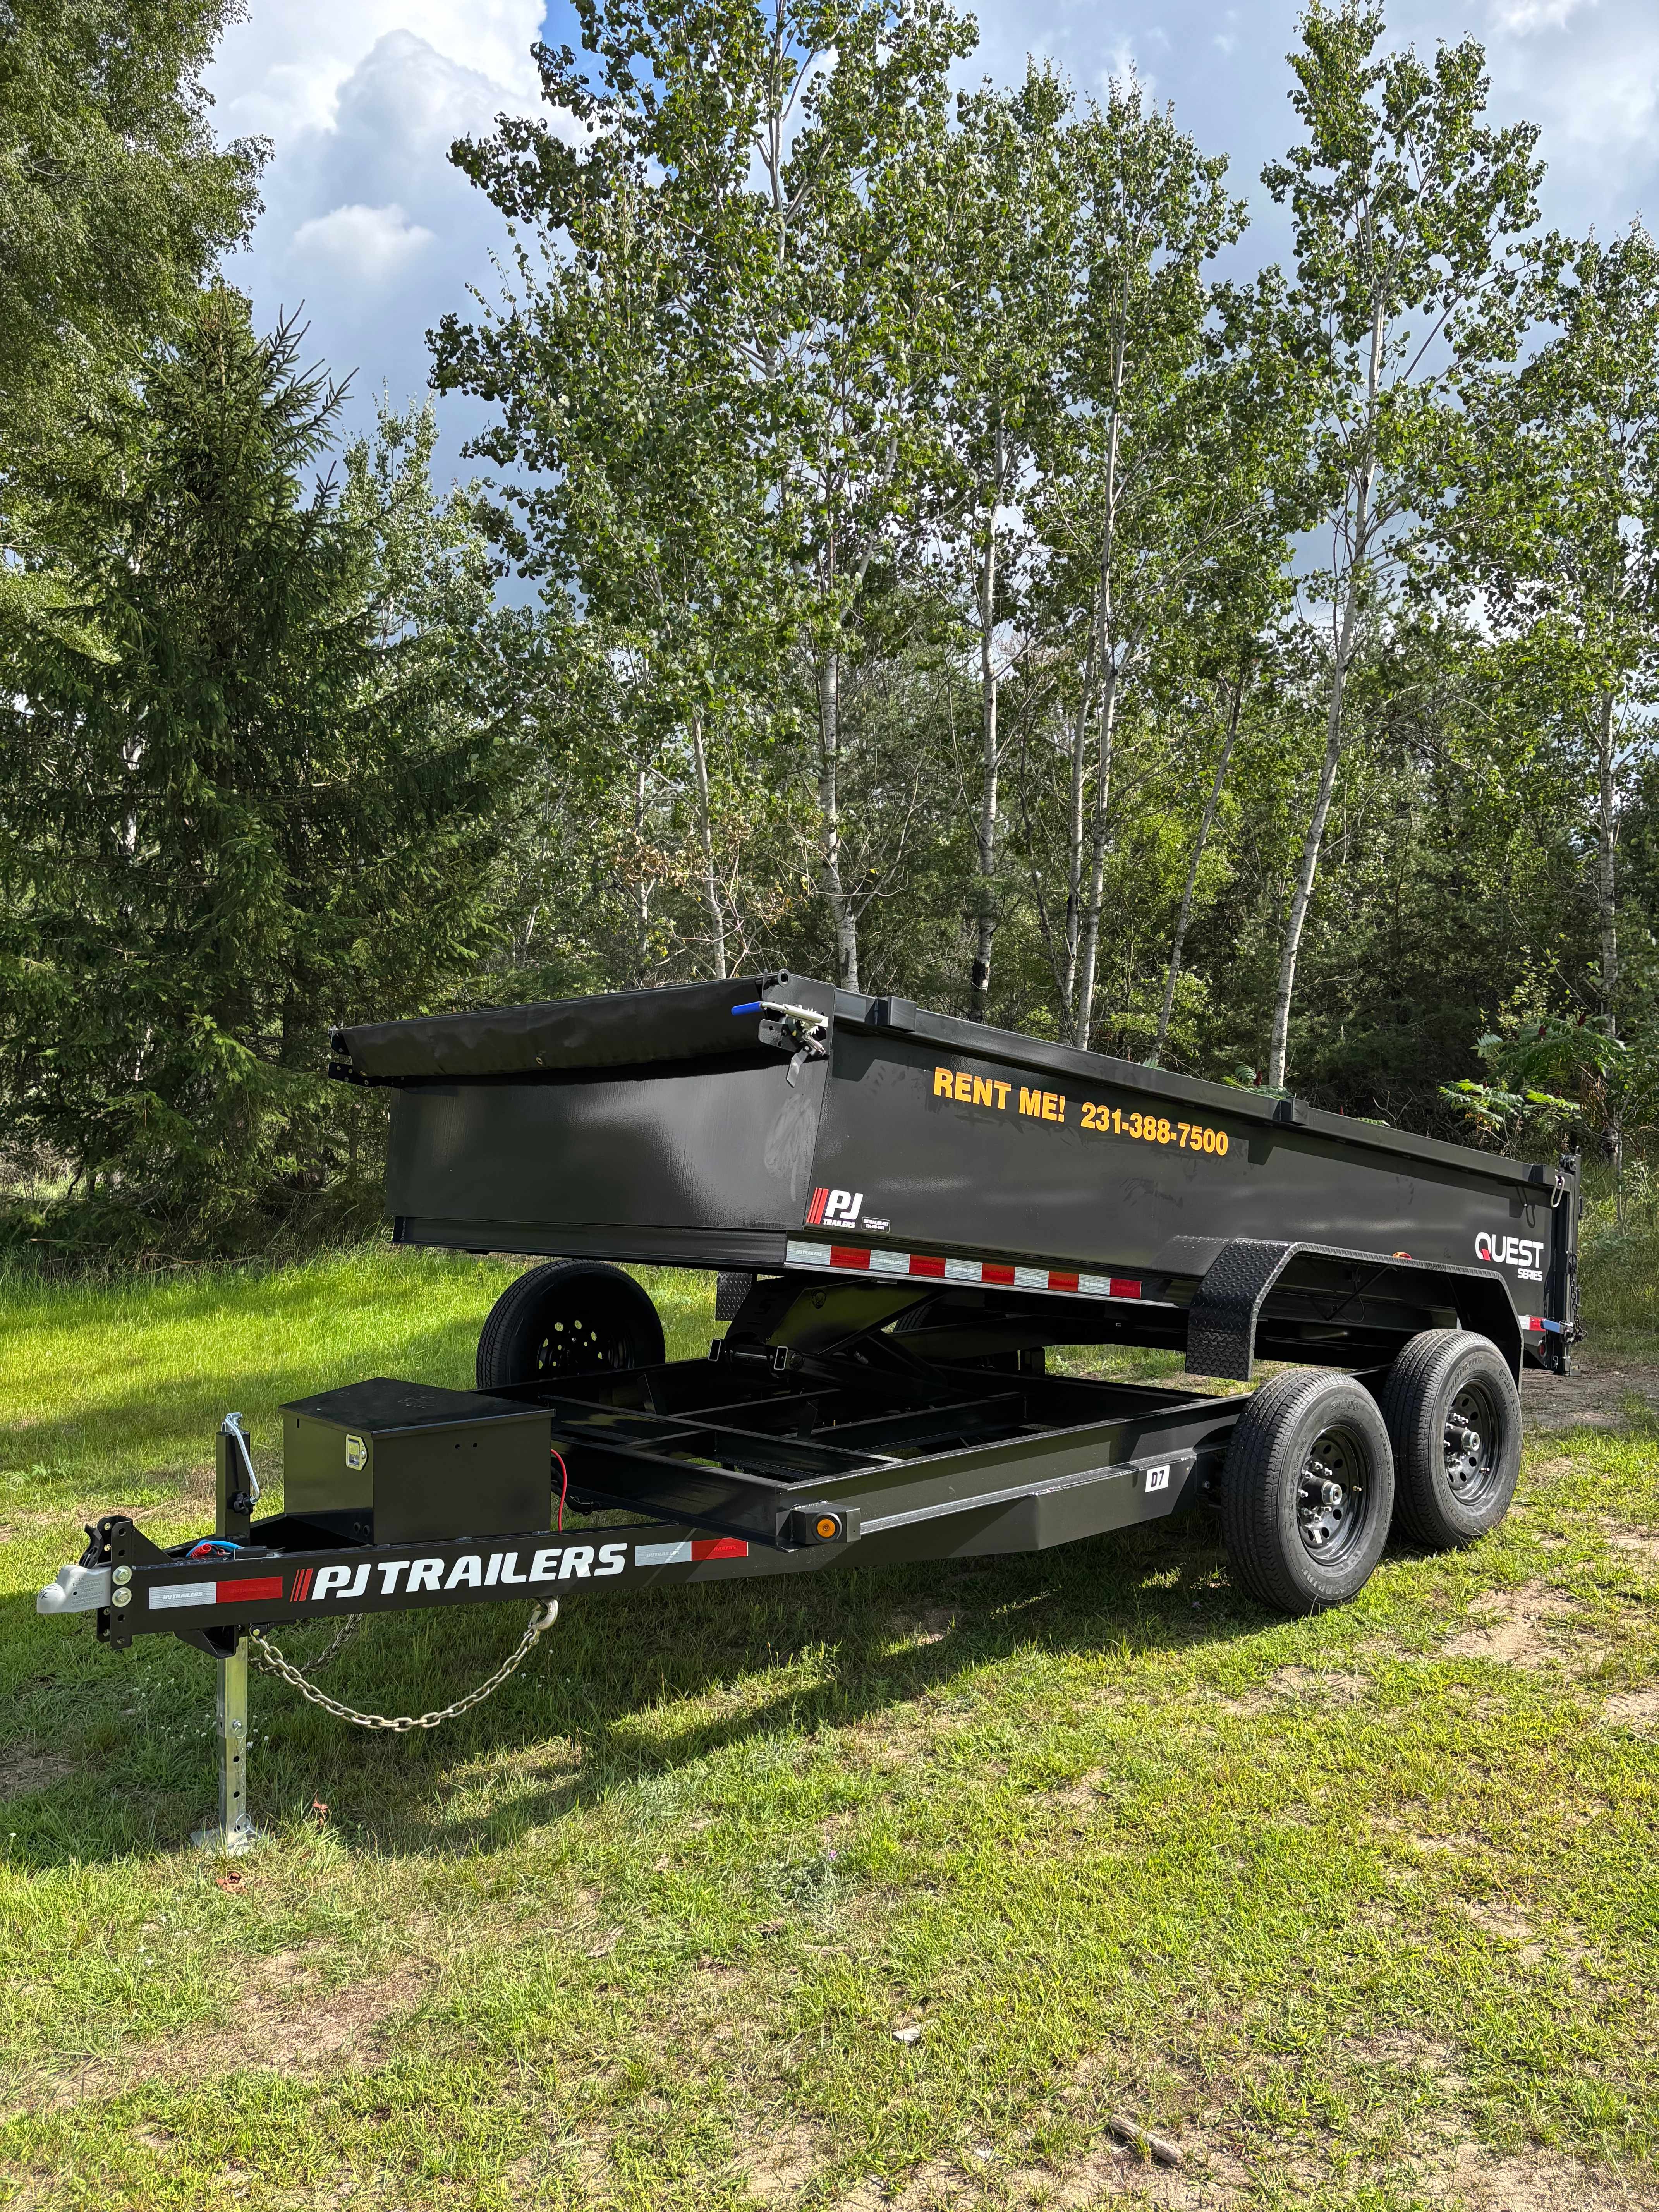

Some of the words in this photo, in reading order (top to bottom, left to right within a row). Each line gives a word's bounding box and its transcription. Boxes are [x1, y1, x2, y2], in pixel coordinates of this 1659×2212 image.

[934, 1067, 1011, 1110] RENT
[1019, 1087, 1065, 1122] ME!
[1081, 1103, 1228, 1156] 231-388-7500
[824, 1190, 864, 1220] PJ
[823, 1218, 856, 1229] TRAILERS
[1475, 1232, 1544, 1269] QUEST
[1517, 1268, 1543, 1281] SERIES
[1151, 1470, 1165, 1488] D7
[311, 1564, 371, 1600] PJ
[377, 1543, 628, 1594] TRAILERS
